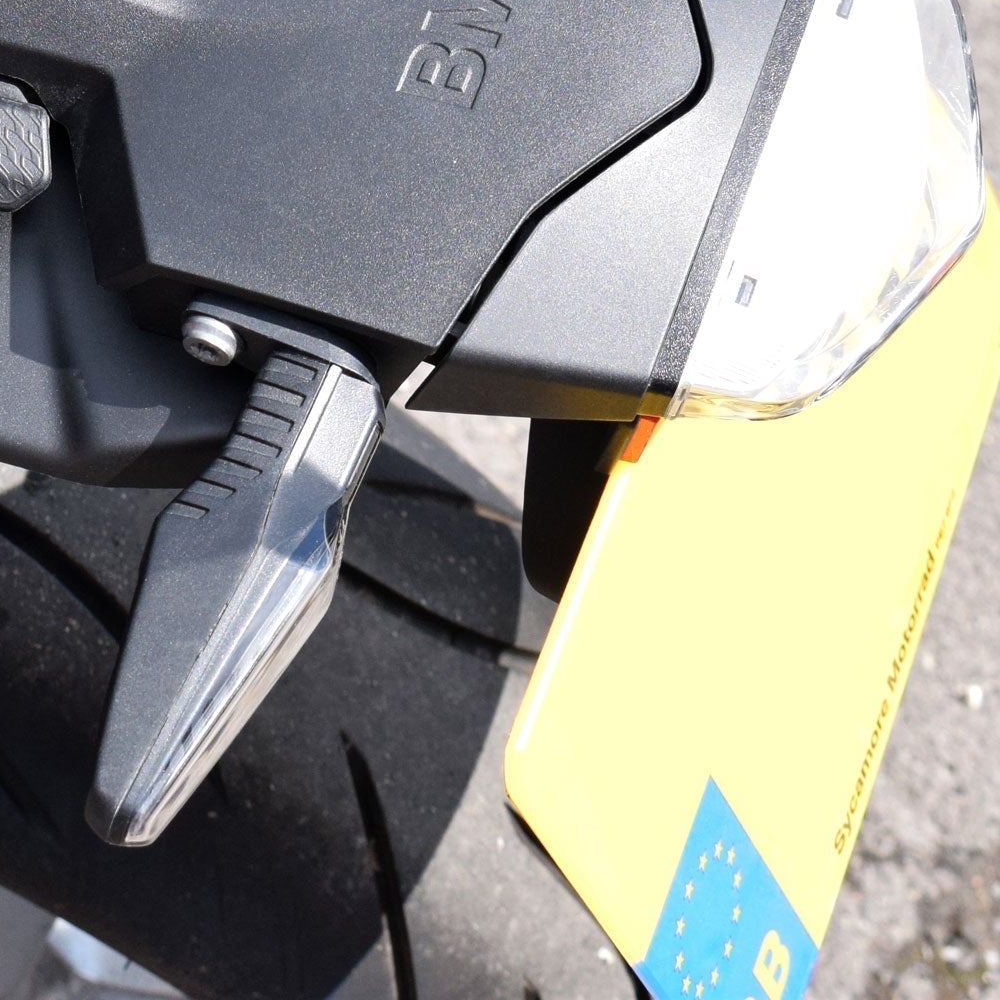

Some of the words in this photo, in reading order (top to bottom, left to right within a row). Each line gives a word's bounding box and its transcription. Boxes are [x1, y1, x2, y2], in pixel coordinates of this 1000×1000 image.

[834, 699, 890, 855] Sycamore
[887, 548, 935, 693] Motorrad
[745, 929, 791, 1000] B
